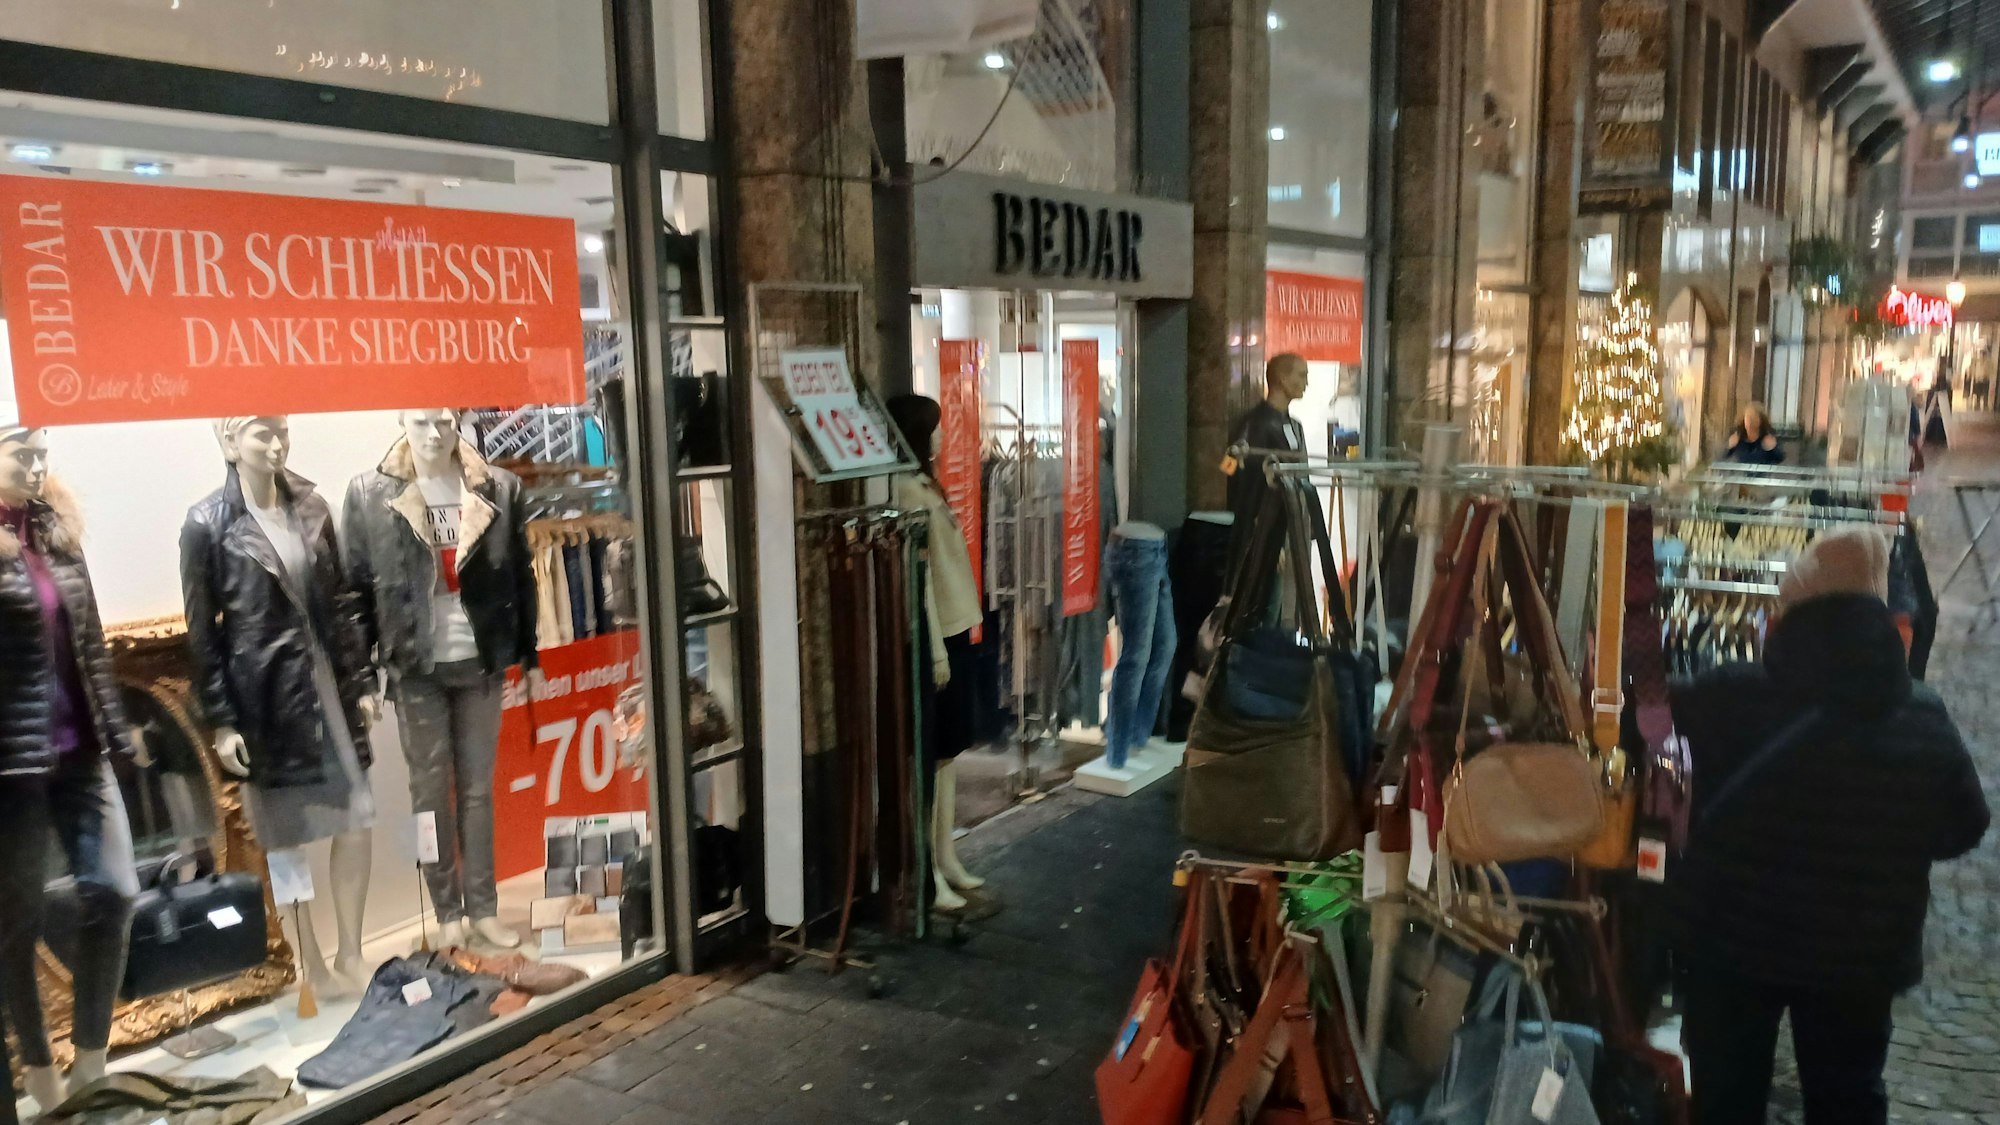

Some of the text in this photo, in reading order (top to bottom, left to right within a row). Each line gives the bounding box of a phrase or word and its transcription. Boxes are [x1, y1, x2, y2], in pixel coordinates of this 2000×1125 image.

[93, 225, 554, 305] WIR SCHLIESSEN
[993, 192, 1143, 282] BEDAR
[18, 200, 77, 356] BEDAR
[181, 315, 531, 367] DANKE SIEGBURG
[1067, 531, 1086, 586] WIR
